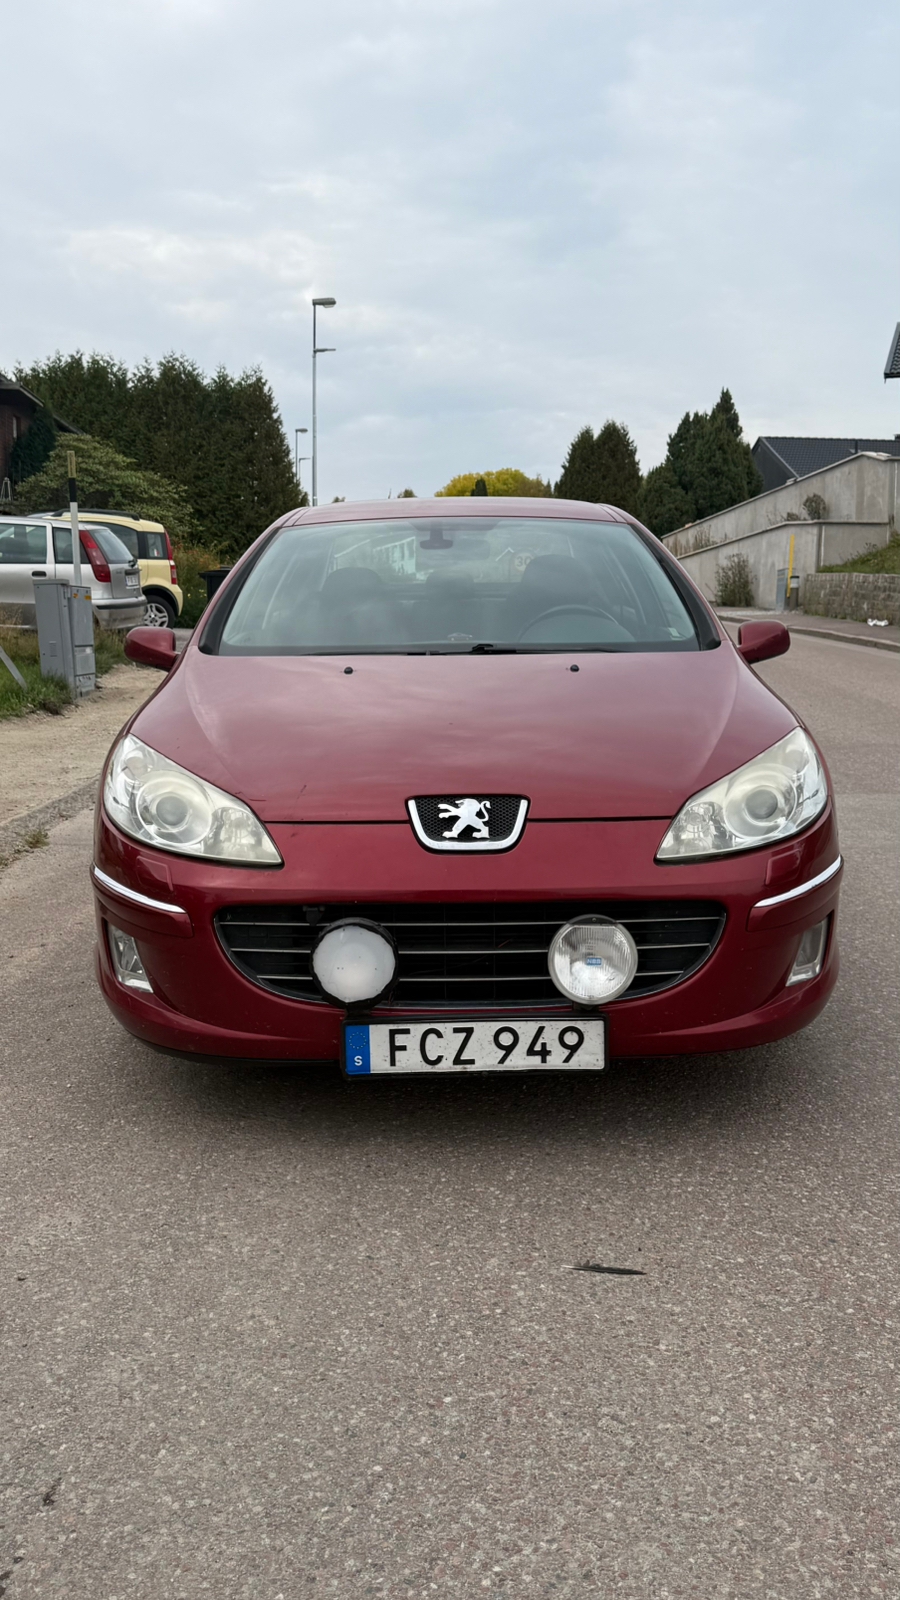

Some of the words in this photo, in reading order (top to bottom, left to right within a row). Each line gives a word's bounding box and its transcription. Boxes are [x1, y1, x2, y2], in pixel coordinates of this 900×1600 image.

[388, 1027, 476, 1067] FCZ
[493, 1025, 585, 1064] 949
[354, 1055, 363, 1066] S
